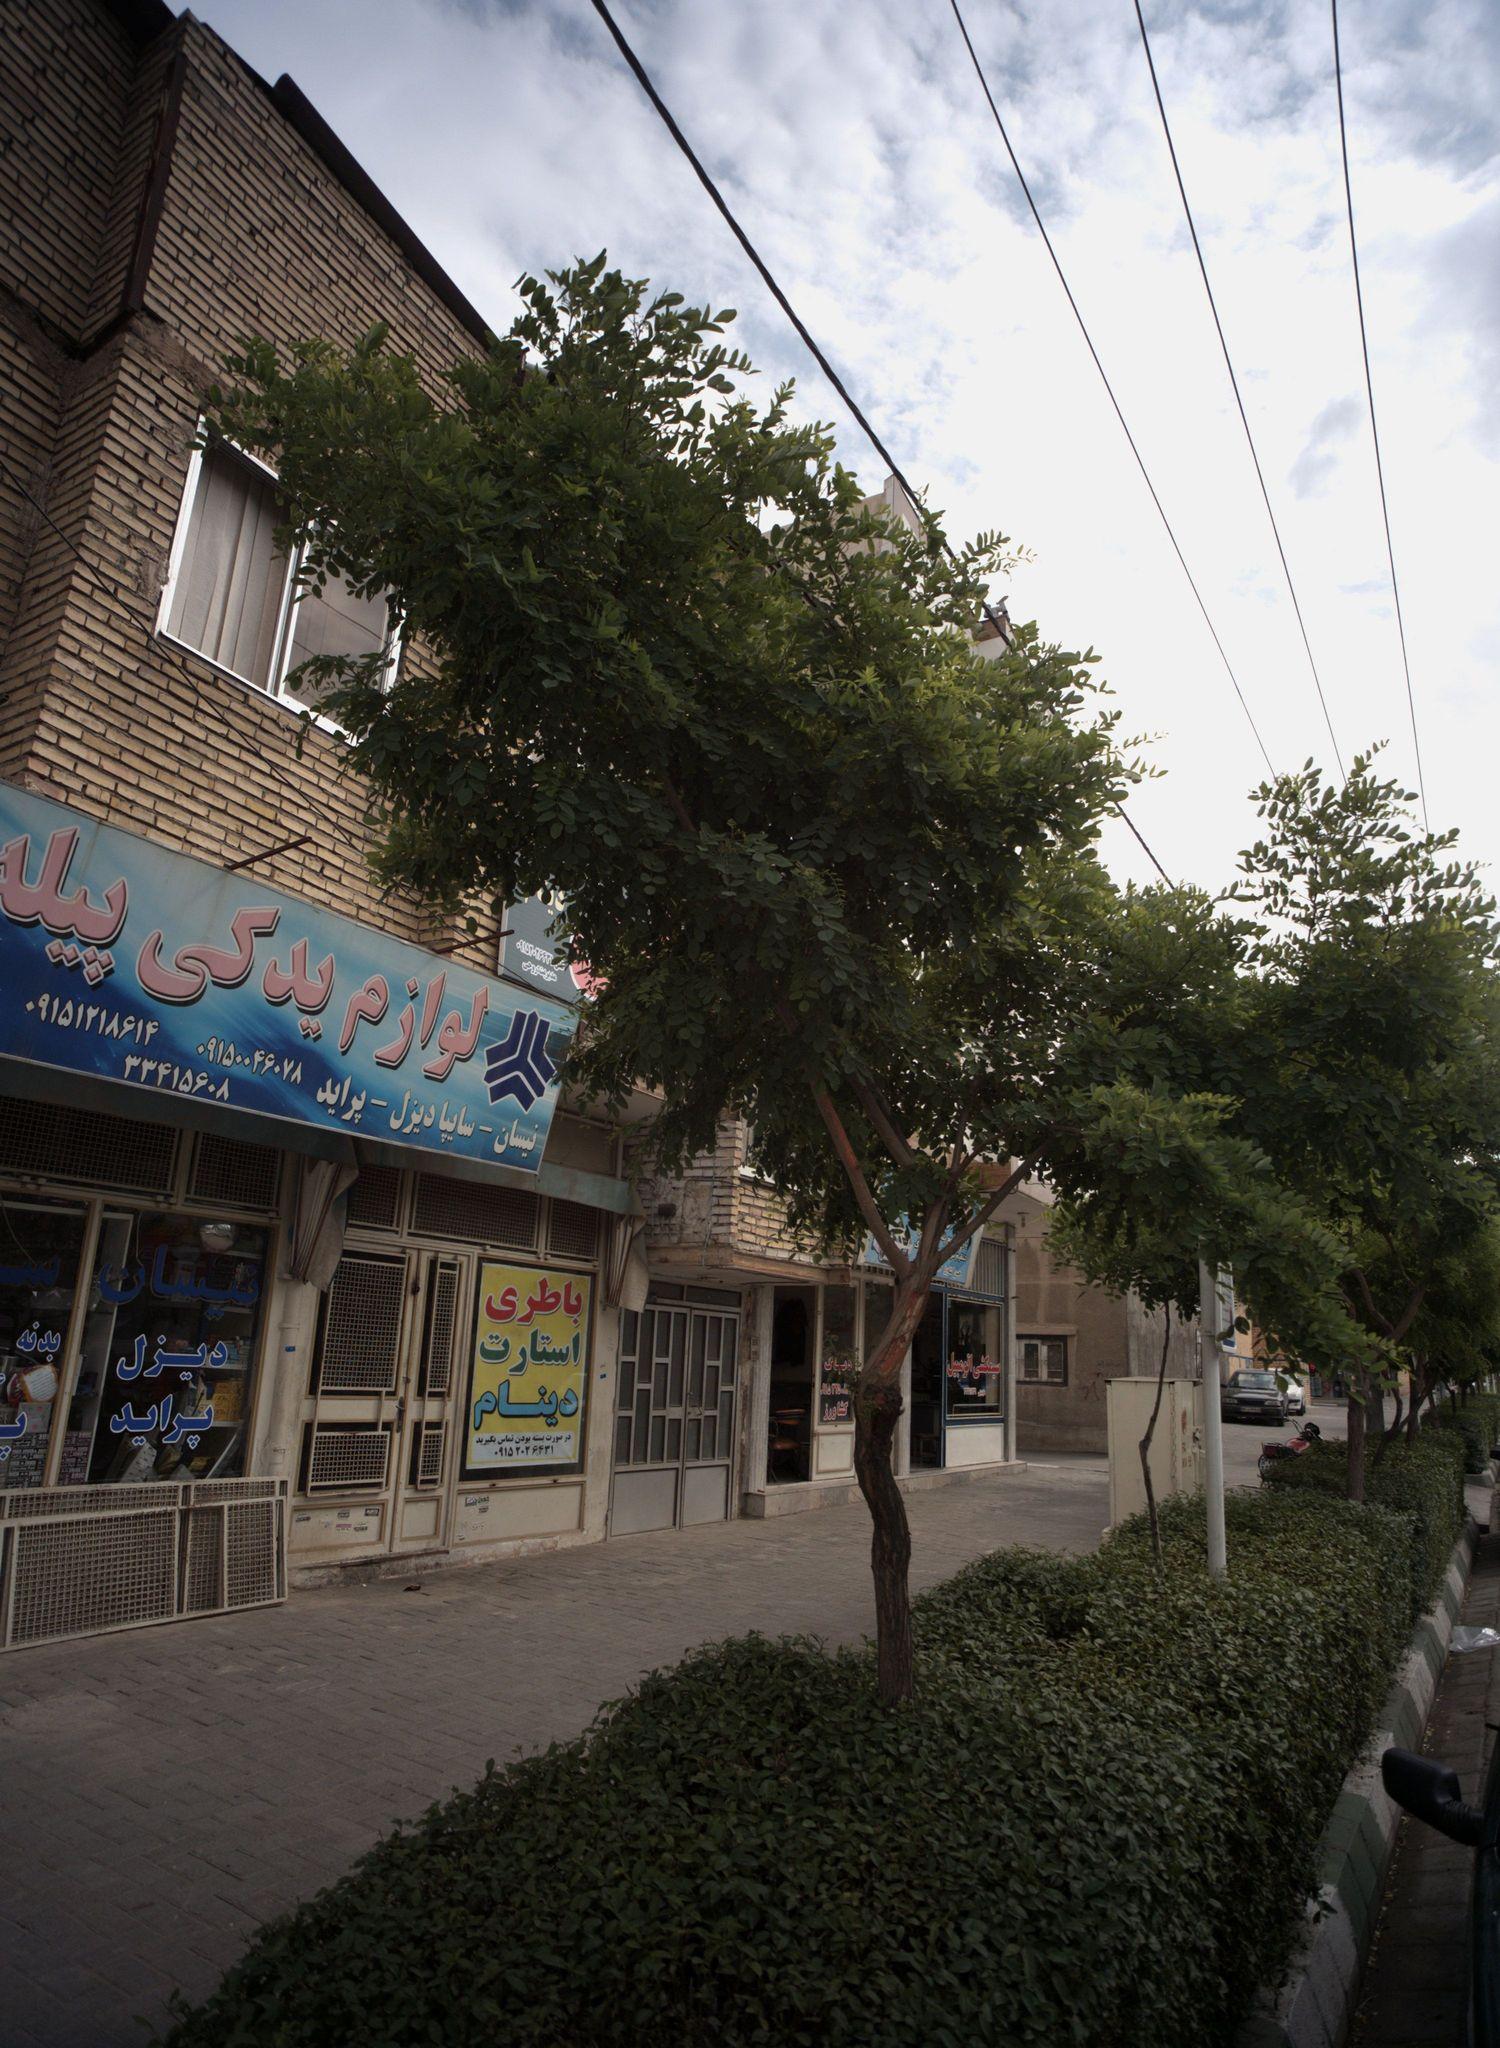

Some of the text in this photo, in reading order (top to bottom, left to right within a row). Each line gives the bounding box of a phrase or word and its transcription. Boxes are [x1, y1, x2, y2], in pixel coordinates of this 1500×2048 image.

[136, 905, 336, 1040] یدکی
[25, 992, 160, 1047] ۰۹۱۵۱۲۱۸۶۱۴
[338, 969, 490, 1078] لوازم
[124, 1053, 230, 1101] ۳۳۴۱۵۶۰۸
[196, 1036, 302, 1085] ۰۹۱۵۰۰۴۶۰۷۸
[316, 1075, 367, 1124] پراید
[389, 1088, 436, 1135] دیزل
[439, 1100, 475, 1143] سایپا
[493, 1118, 539, 1158] نیسان
[485, 1277, 583, 1328] باطری
[16, 1321, 61, 1362] بدنه
[116, 1334, 228, 1381] دیزل
[479, 1328, 580, 1376] استارت
[110, 1394, 214, 1449] پراید
[473, 1379, 579, 1430] دینام
